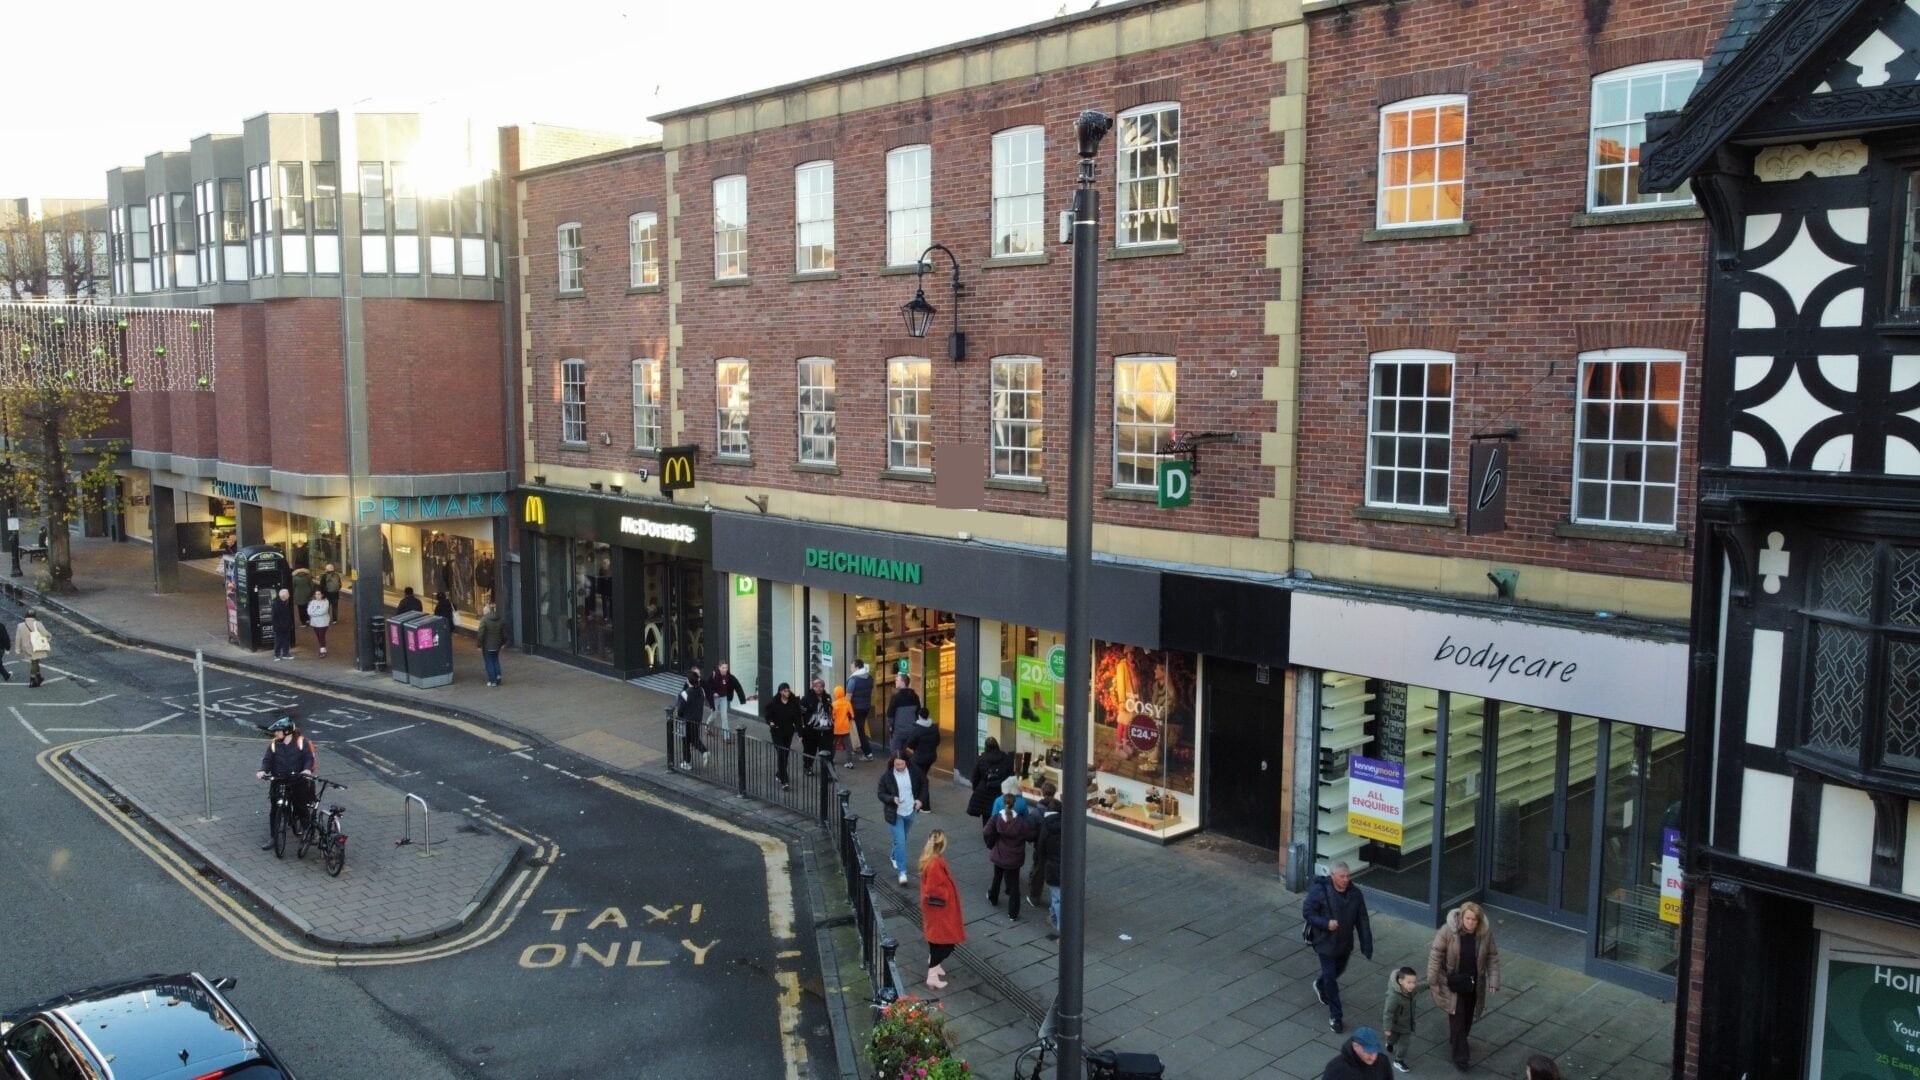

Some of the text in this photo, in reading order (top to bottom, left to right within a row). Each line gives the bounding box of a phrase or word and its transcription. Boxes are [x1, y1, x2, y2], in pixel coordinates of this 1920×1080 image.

[211, 479, 259, 503] PRIMARK
[1167, 469, 1187, 499] D
[358, 491, 508, 522] PRIMARK
[620, 516, 697, 543] McDonald's
[805, 548, 921, 584] DEICHMANN
[739, 576, 753, 592] D
[1434, 635, 1577, 683] bodycare
[1125, 698, 1164, 719] COSY
[1391, 687, 1405, 703] big
[1352, 796, 1400, 816] ENQUIRIES
[1368, 790, 1384, 801] ALL
[542, 903, 703, 931] TAXI
[518, 939, 721, 968] ONLY
[1874, 965, 1920, 994] Holl
[1905, 1040, 1915, 1053] is
